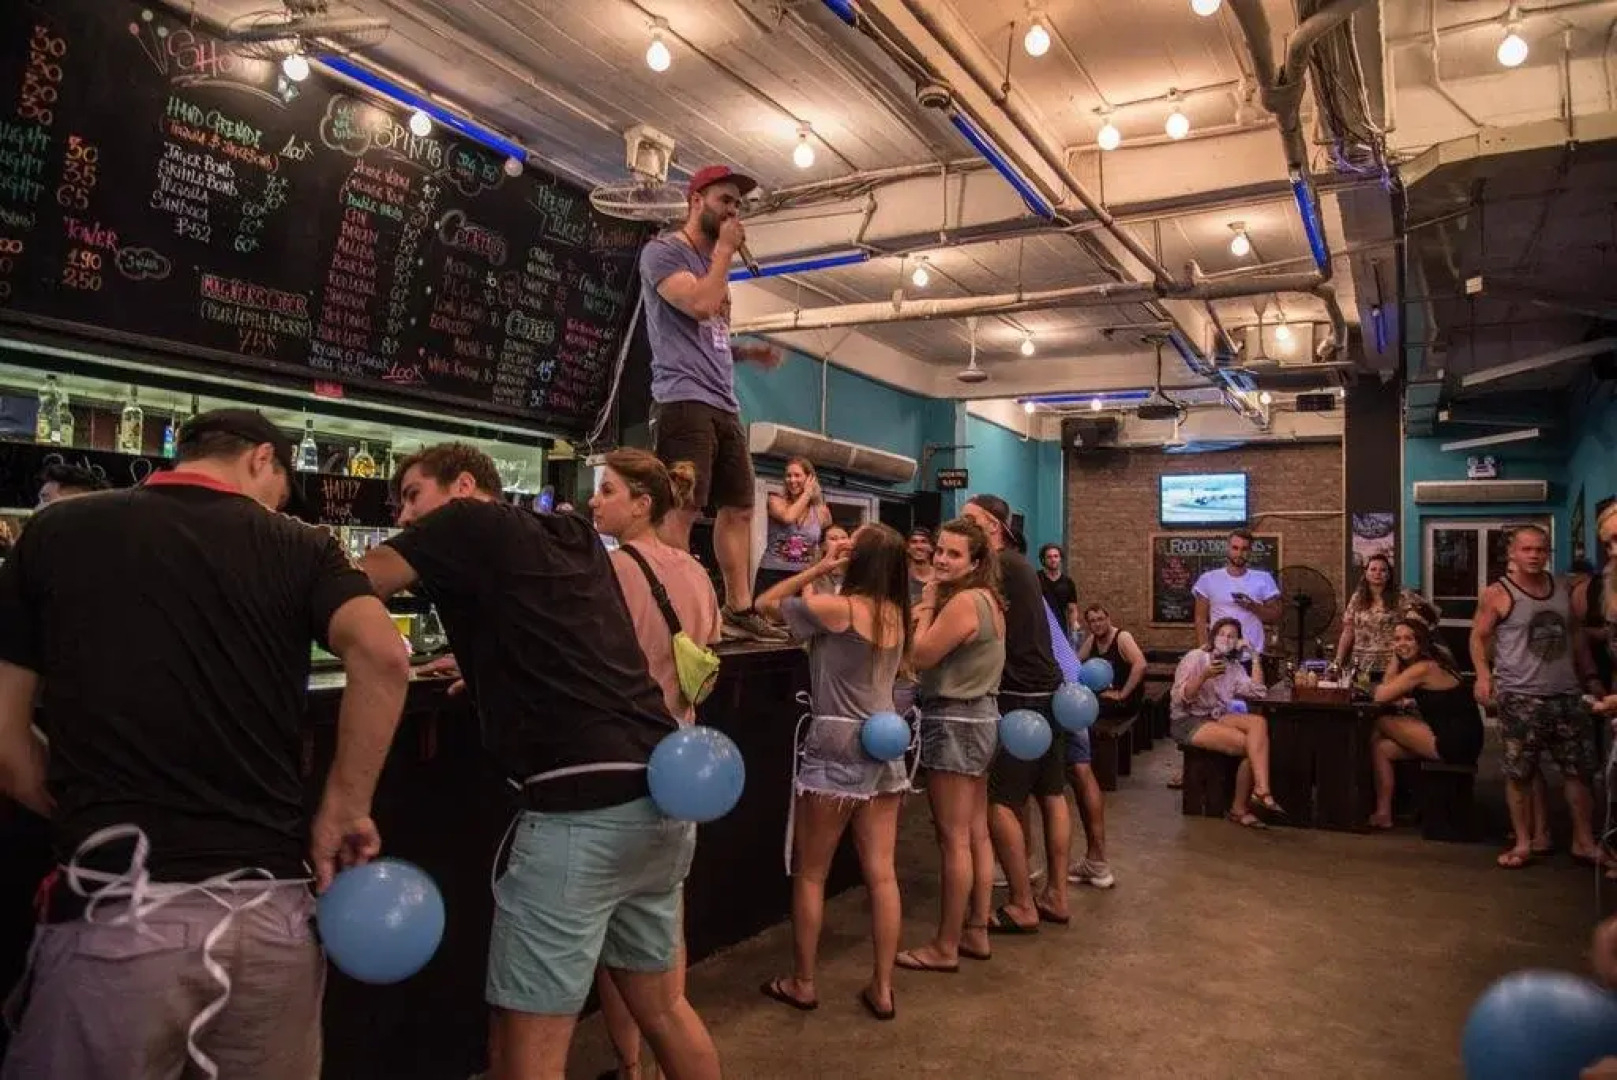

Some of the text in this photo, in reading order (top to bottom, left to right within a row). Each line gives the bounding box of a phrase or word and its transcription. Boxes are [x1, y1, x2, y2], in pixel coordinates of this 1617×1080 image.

[166, 95, 204, 128] HAND
[66, 247, 102, 272] 190
[62, 267, 102, 292] 250
